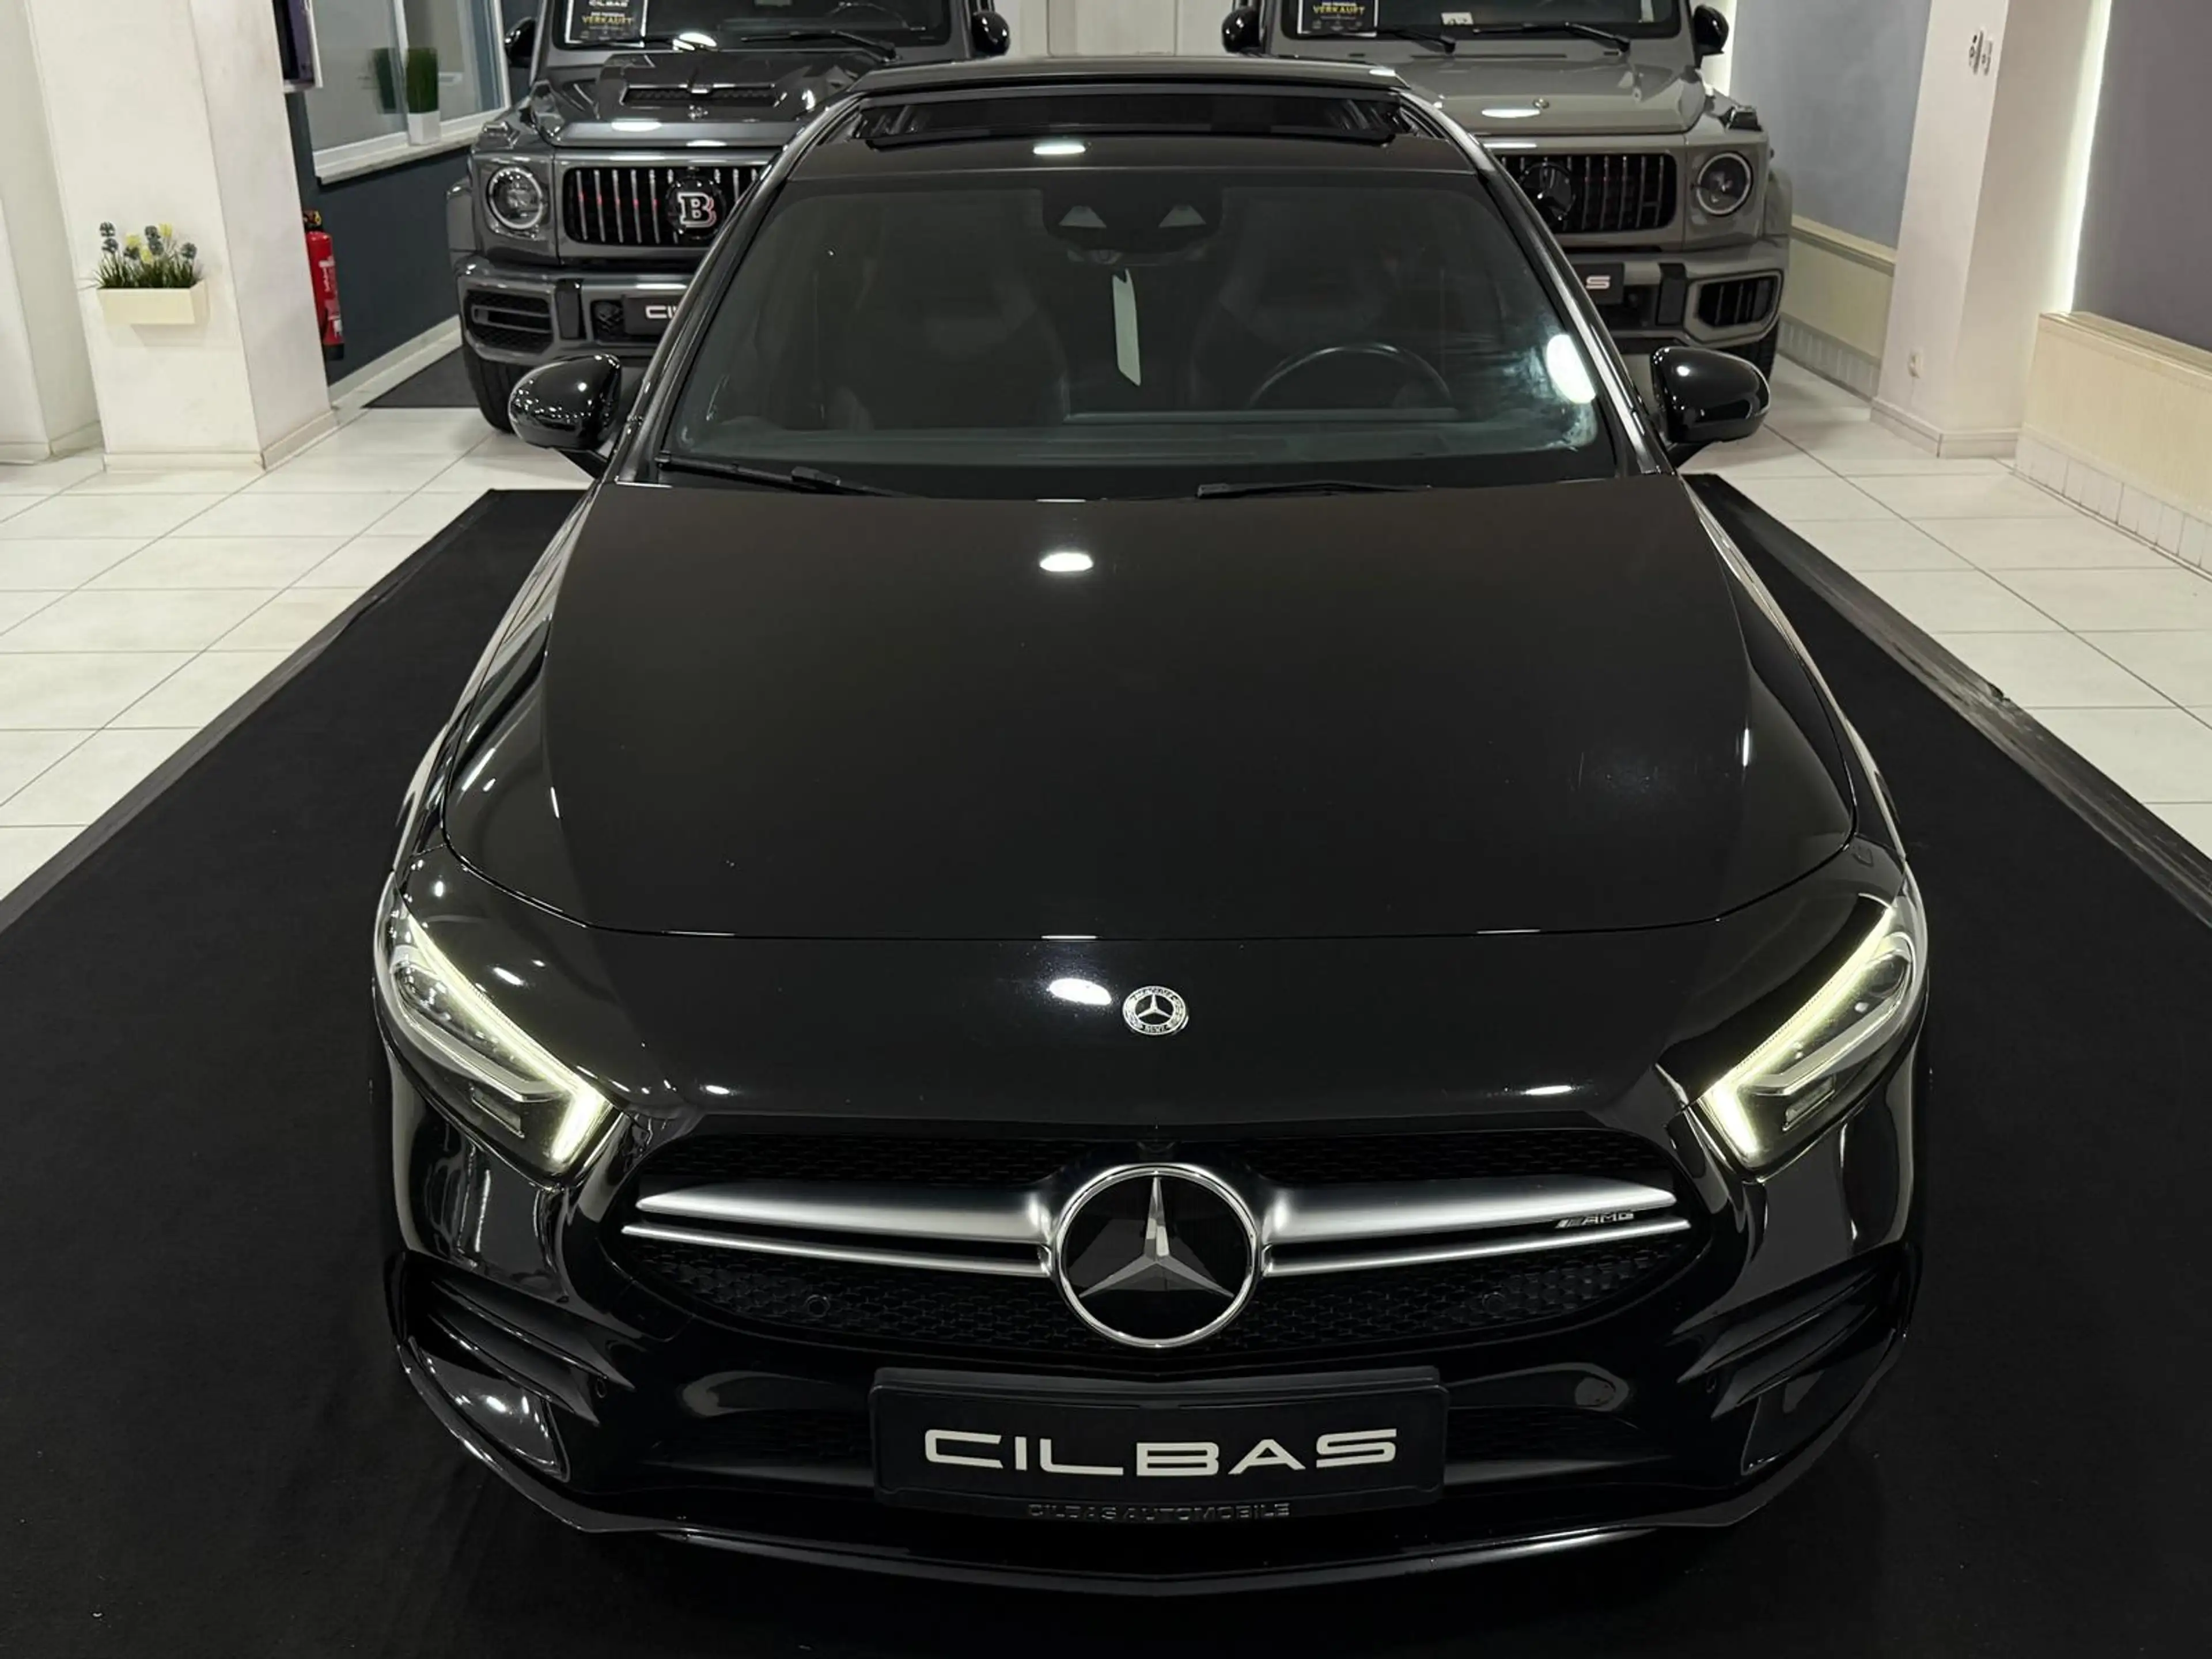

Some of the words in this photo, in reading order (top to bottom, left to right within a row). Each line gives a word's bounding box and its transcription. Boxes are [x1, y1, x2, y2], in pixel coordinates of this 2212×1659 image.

[677, 192, 717, 228] B
[924, 1428, 1397, 1478] CILBAS
[1028, 1503, 1118, 1520] CILBAS
[1122, 1502, 1290, 1522] AUTOMOBILE
